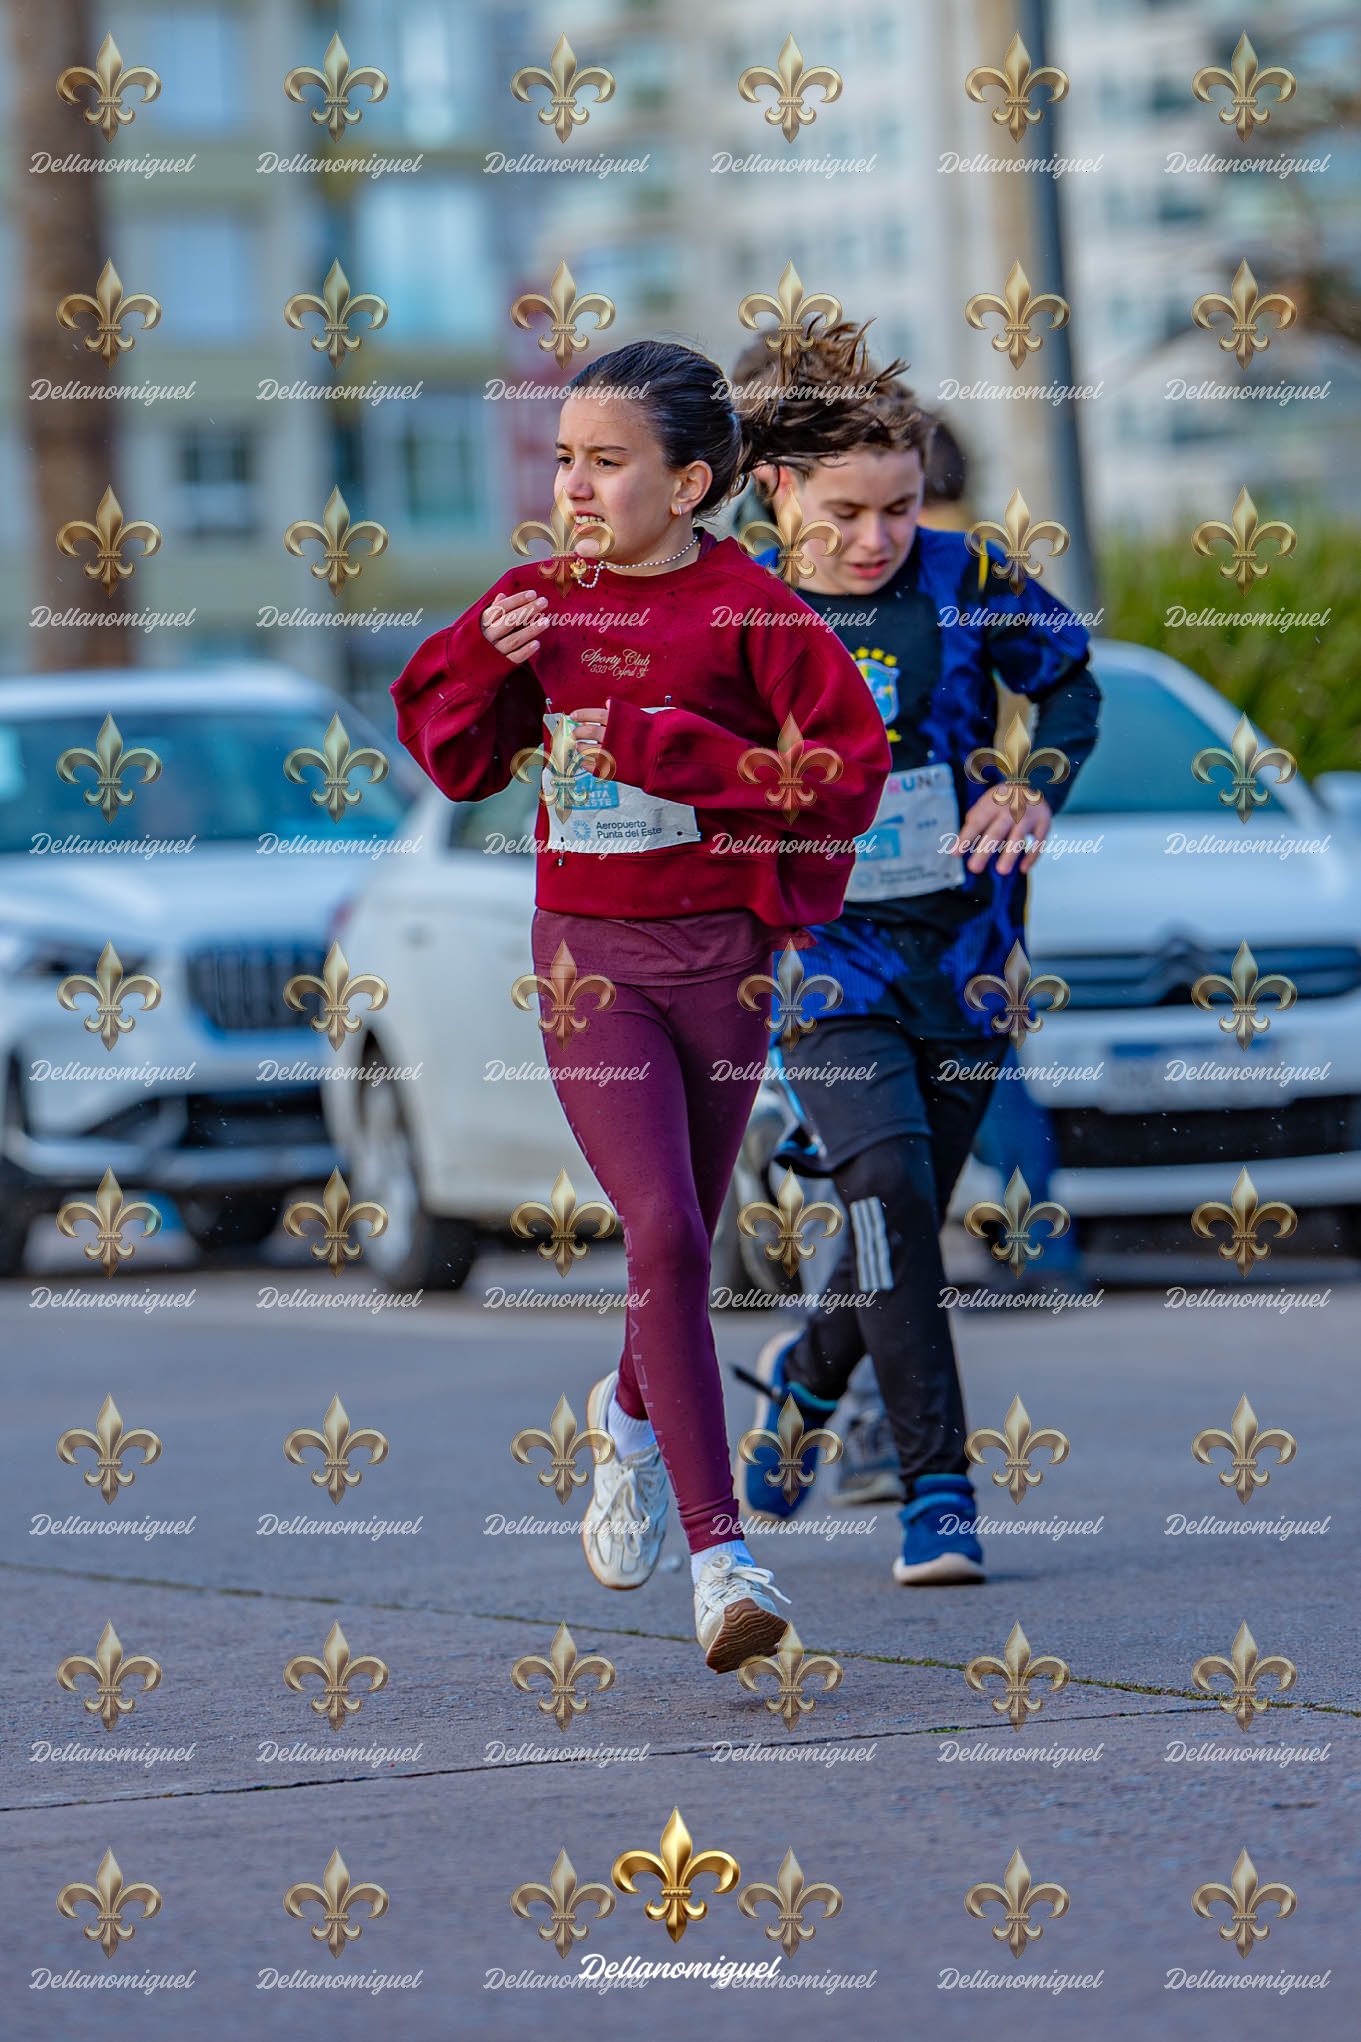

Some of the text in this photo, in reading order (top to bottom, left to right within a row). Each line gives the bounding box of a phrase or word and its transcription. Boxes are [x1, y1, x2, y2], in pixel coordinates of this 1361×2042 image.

[581, 648, 651, 670] Sporty Club
[596, 820, 647, 830] Aeropuerto
[597, 826, 663, 839] Punta del Este
